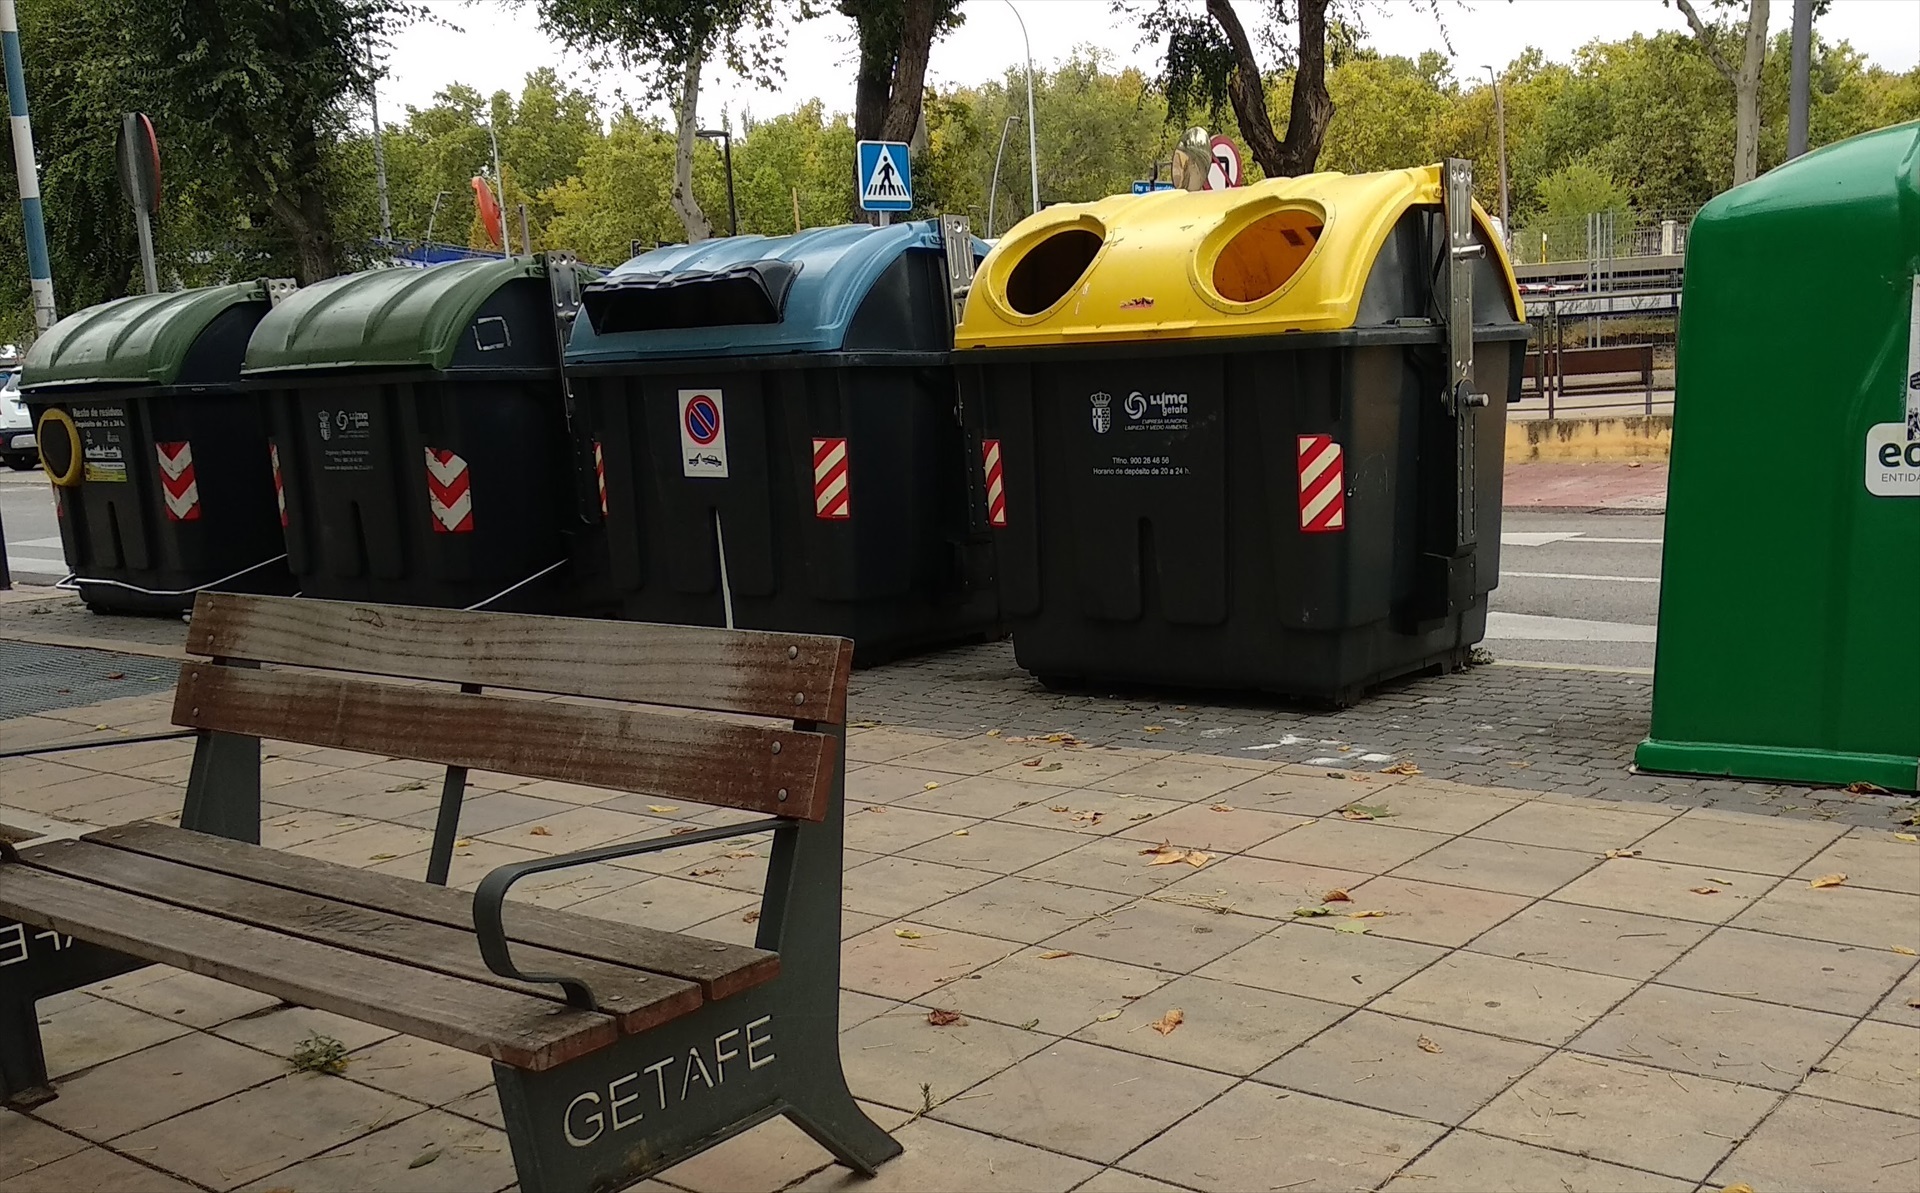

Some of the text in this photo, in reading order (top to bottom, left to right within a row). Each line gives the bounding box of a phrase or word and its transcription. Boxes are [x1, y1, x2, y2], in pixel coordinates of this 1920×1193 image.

[1160, 467, 1169, 475] 20
[1175, 467, 1183, 475] 24
[563, 1014, 777, 1147] GETAFE
